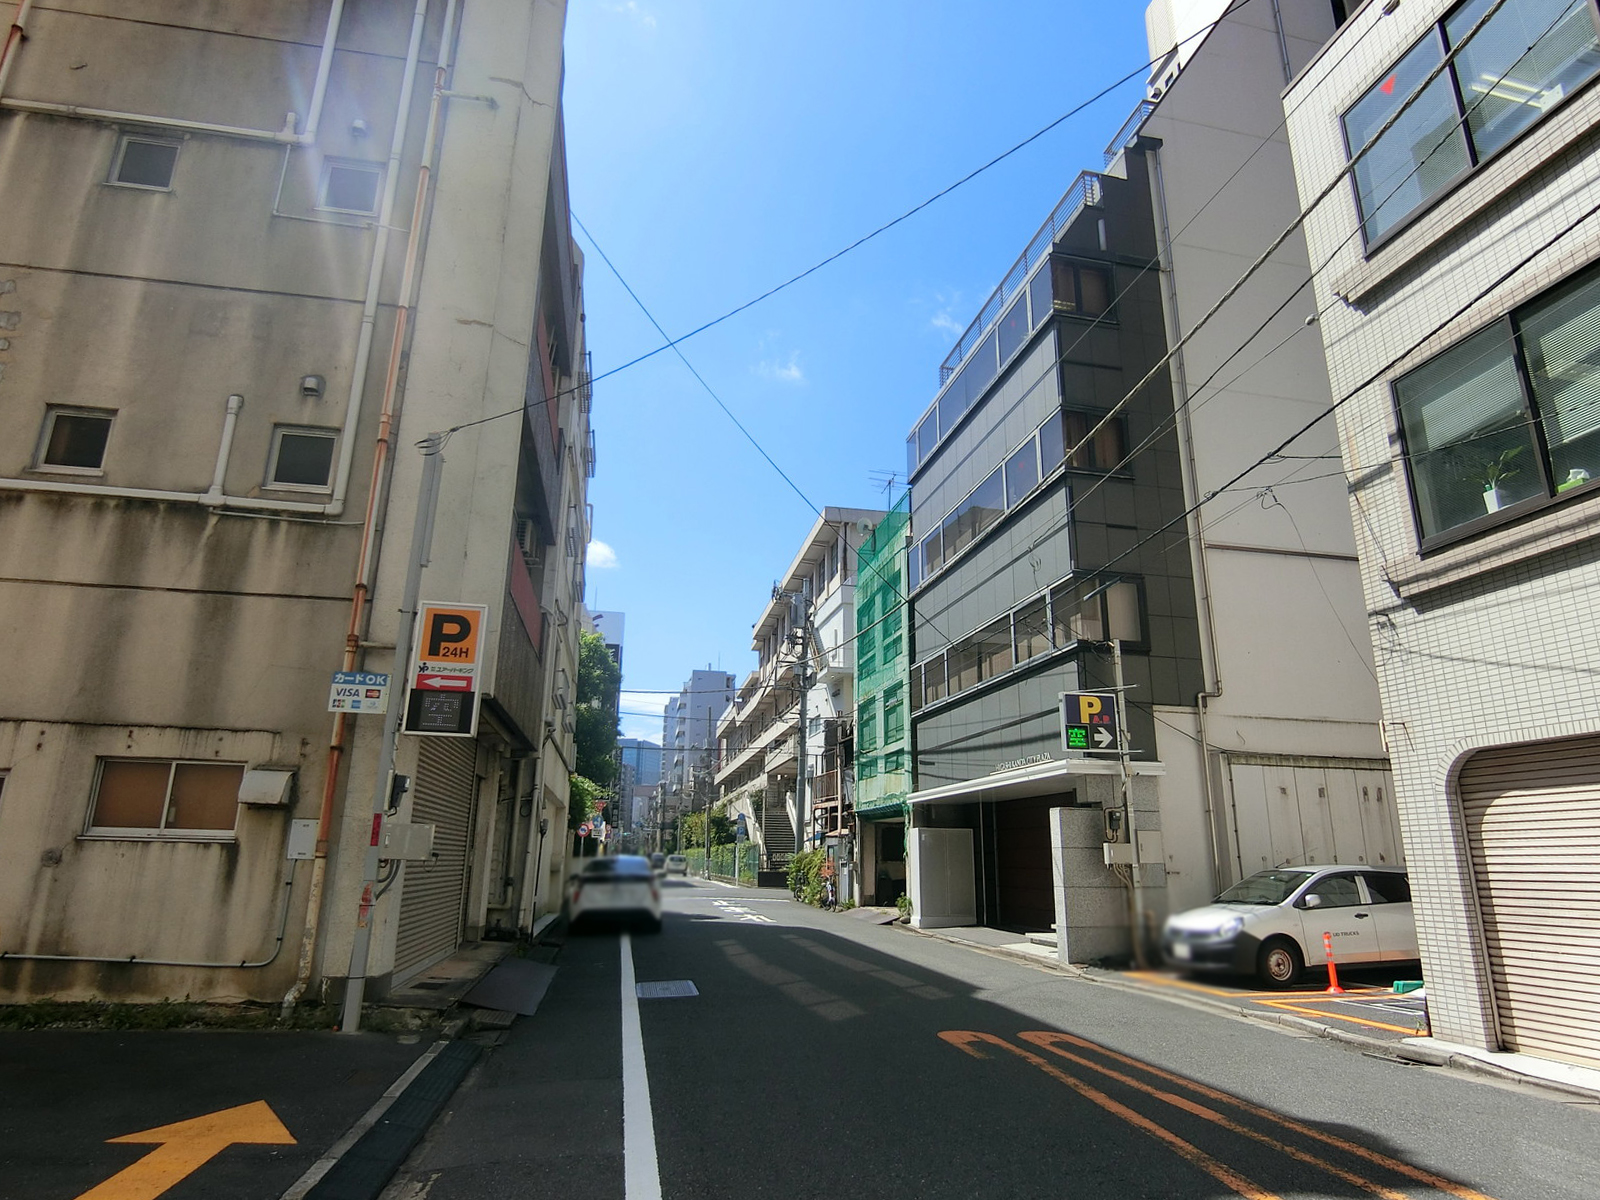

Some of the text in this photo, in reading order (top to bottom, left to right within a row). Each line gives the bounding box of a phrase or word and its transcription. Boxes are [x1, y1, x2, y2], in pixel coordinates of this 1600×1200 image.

[428, 613, 471, 656] P
[441, 646, 469, 658] 24H
[336, 687, 360, 697] VISA
[1079, 695, 1102, 724] P
